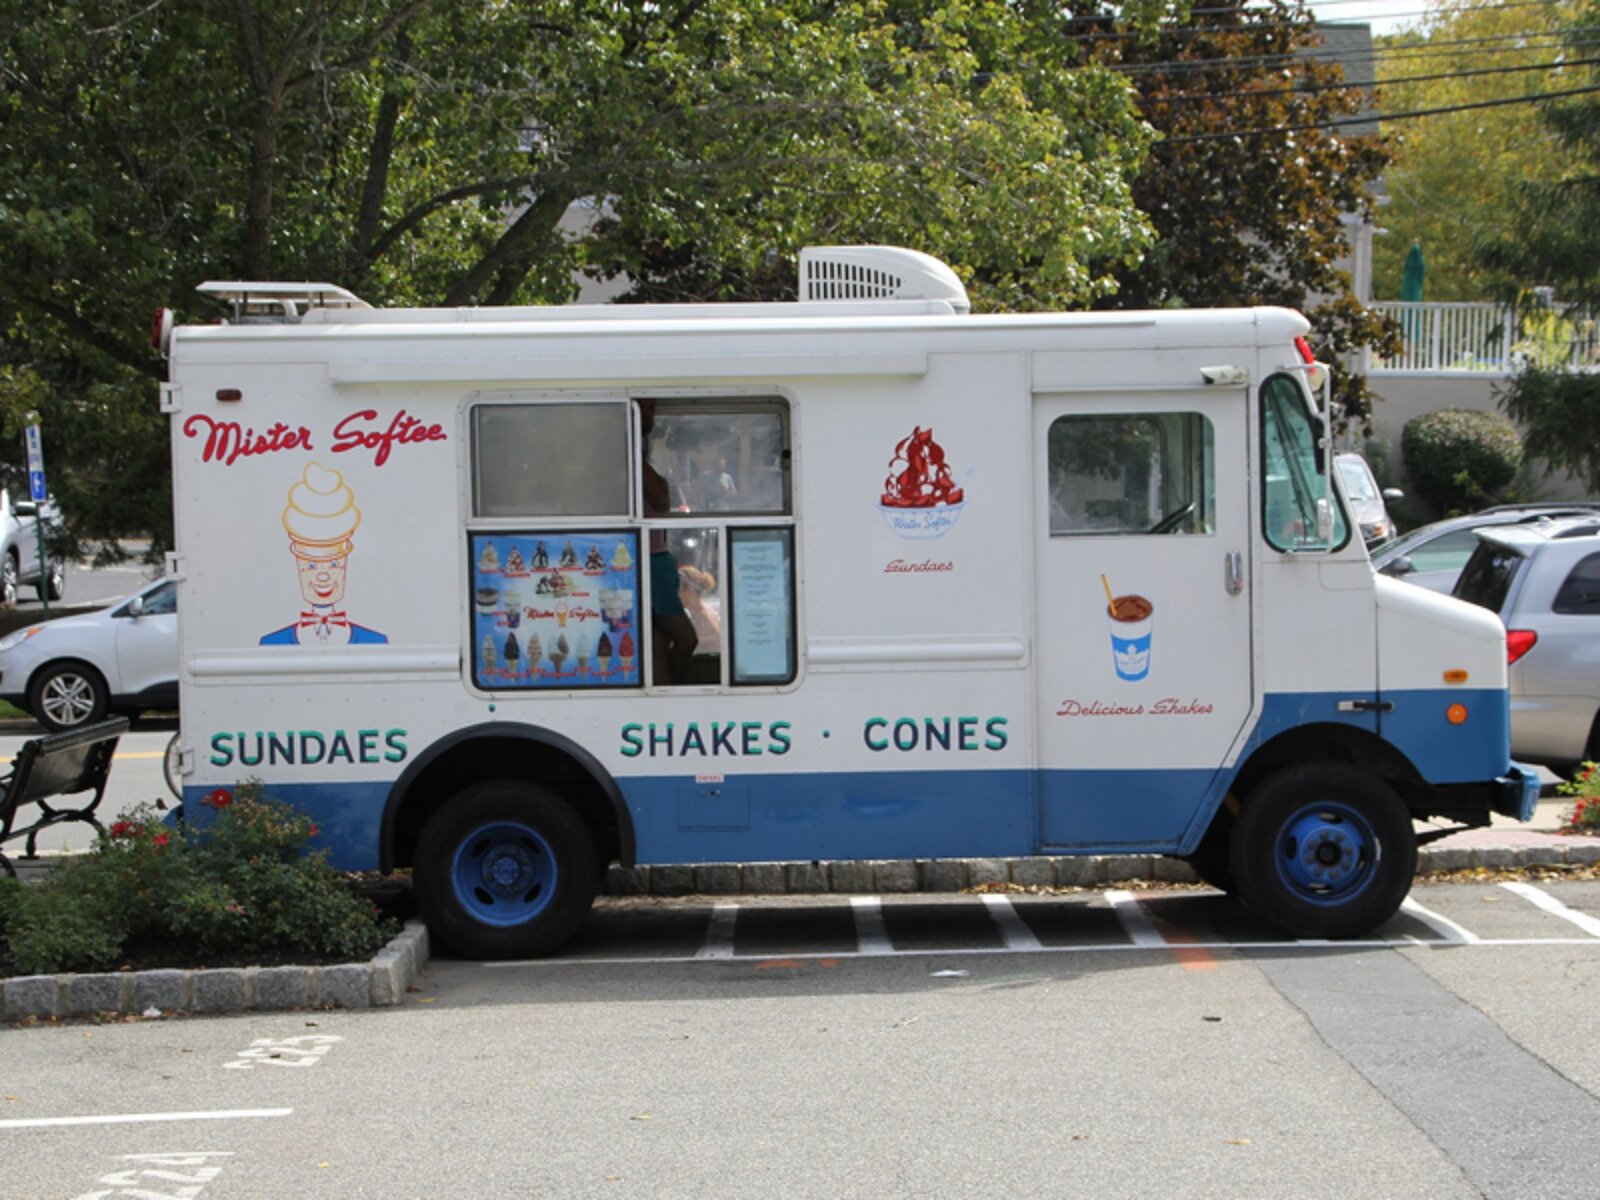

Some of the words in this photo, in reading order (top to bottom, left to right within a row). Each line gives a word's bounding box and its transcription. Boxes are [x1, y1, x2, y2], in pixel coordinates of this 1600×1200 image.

[183, 413, 313, 466] Mister
[331, 409, 448, 466] Softee
[883, 559, 954, 573] Sundaes
[1056, 699, 1145, 717] Delicious
[1148, 697, 1214, 715] Shakes
[210, 728, 409, 767] SUNDAES
[620, 720, 792, 757] SHAKES
[863, 716, 1008, 752] CONES
